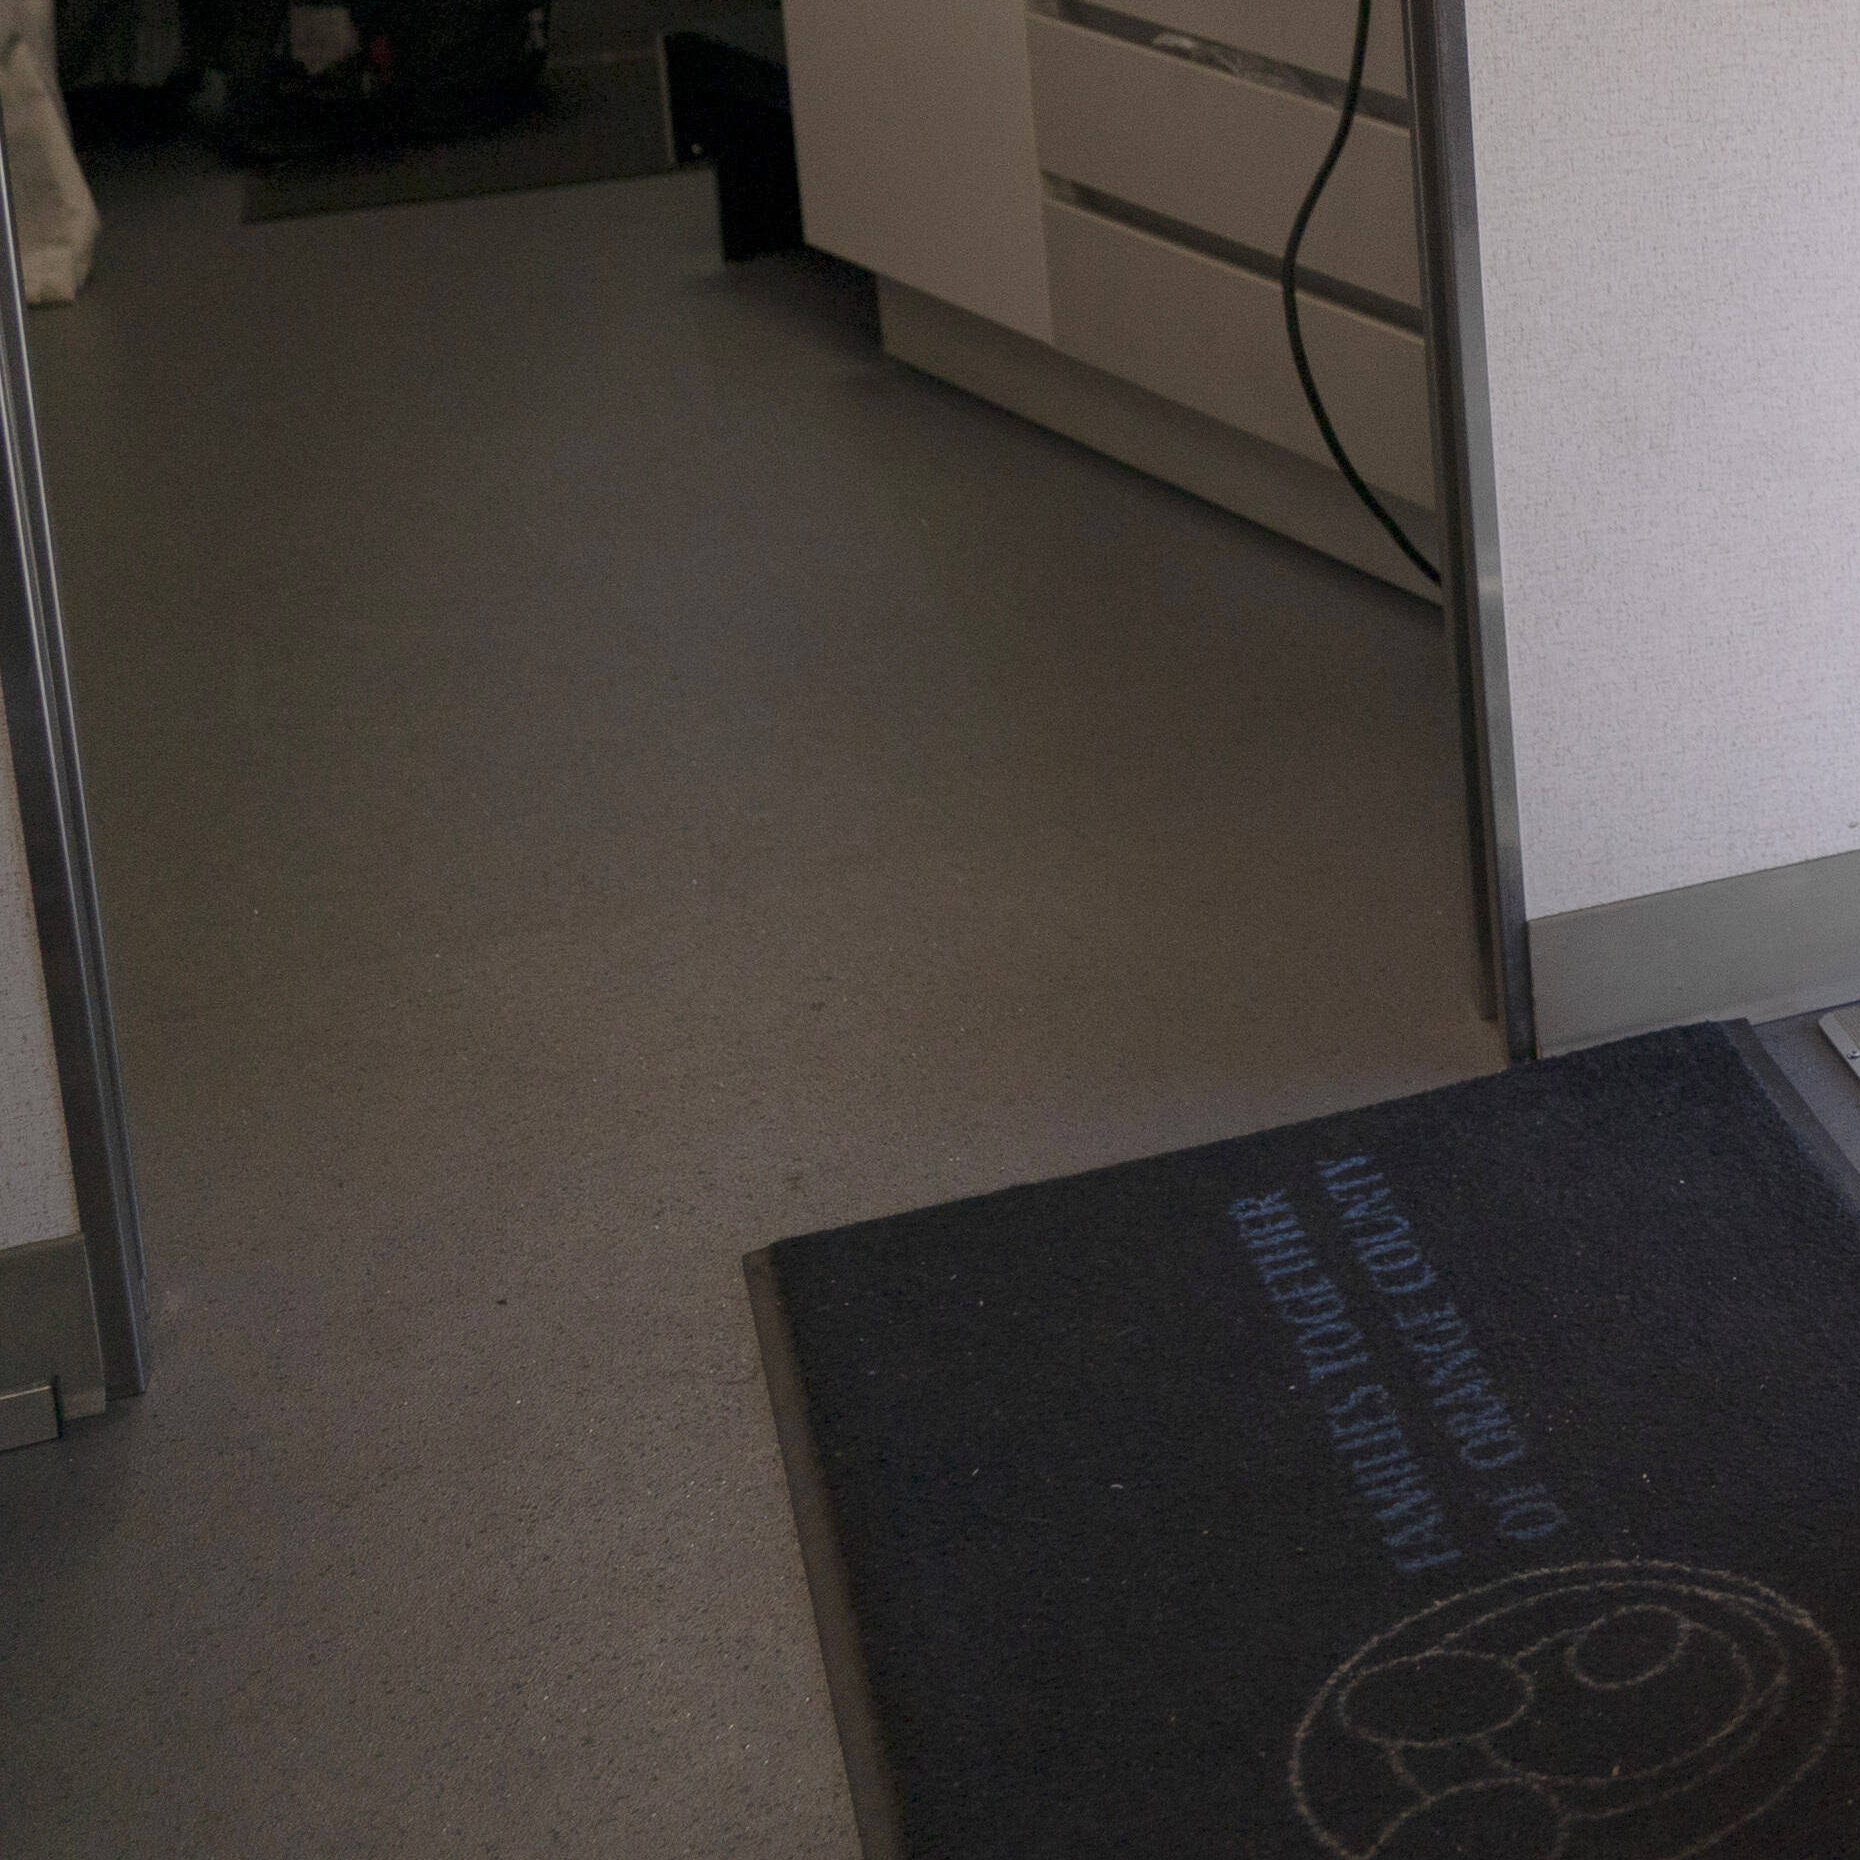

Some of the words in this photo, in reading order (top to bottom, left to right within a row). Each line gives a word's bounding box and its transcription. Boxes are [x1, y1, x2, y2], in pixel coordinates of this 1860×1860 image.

[1230, 1188, 1370, 1384] TOGETHER
[1316, 1155, 1438, 1296] COUNTY
[1398, 1300, 1526, 1472] ORANGE
[1328, 1384, 1462, 1572] FAMILIES
